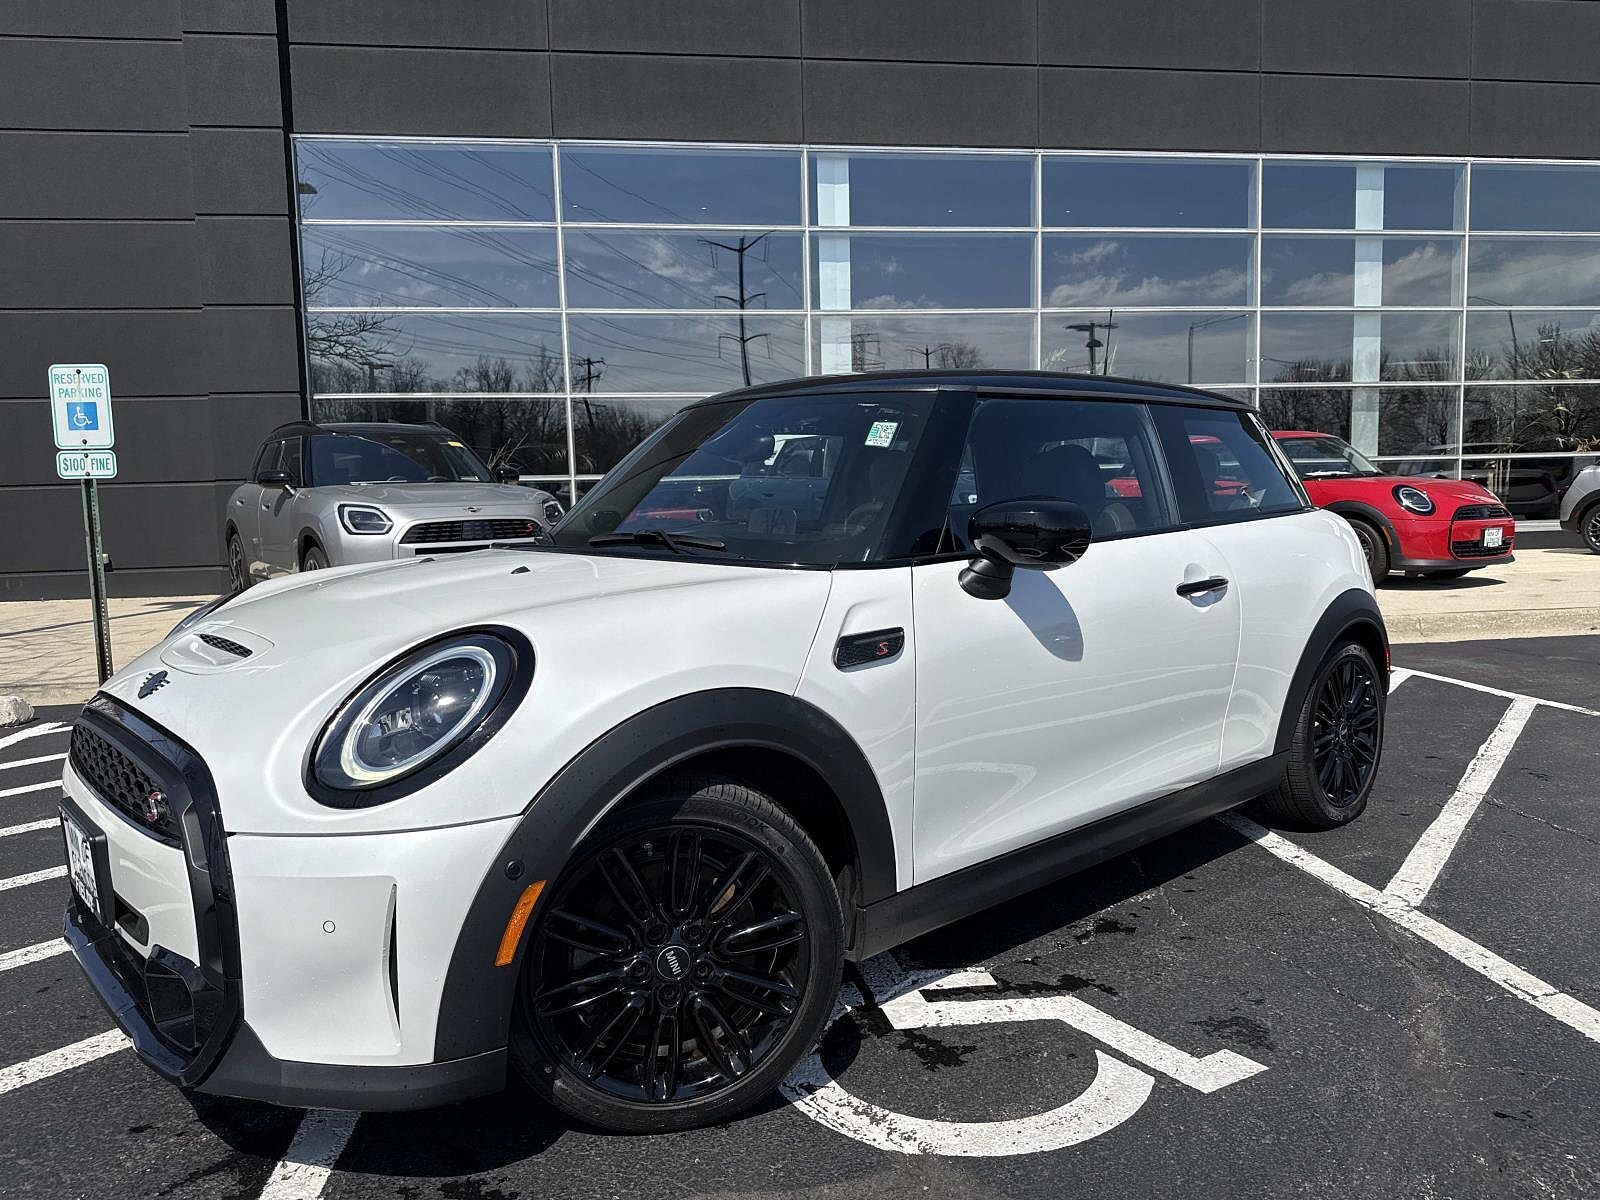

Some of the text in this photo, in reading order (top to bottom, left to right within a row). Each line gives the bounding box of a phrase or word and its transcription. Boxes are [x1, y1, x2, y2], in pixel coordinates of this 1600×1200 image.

[53, 373, 104, 385] RESERVED
[58, 387, 102, 398] PARKING
[62, 457, 111, 472] $100 FINE
[875, 641, 890, 656] S
[665, 950, 682, 975] MINI
